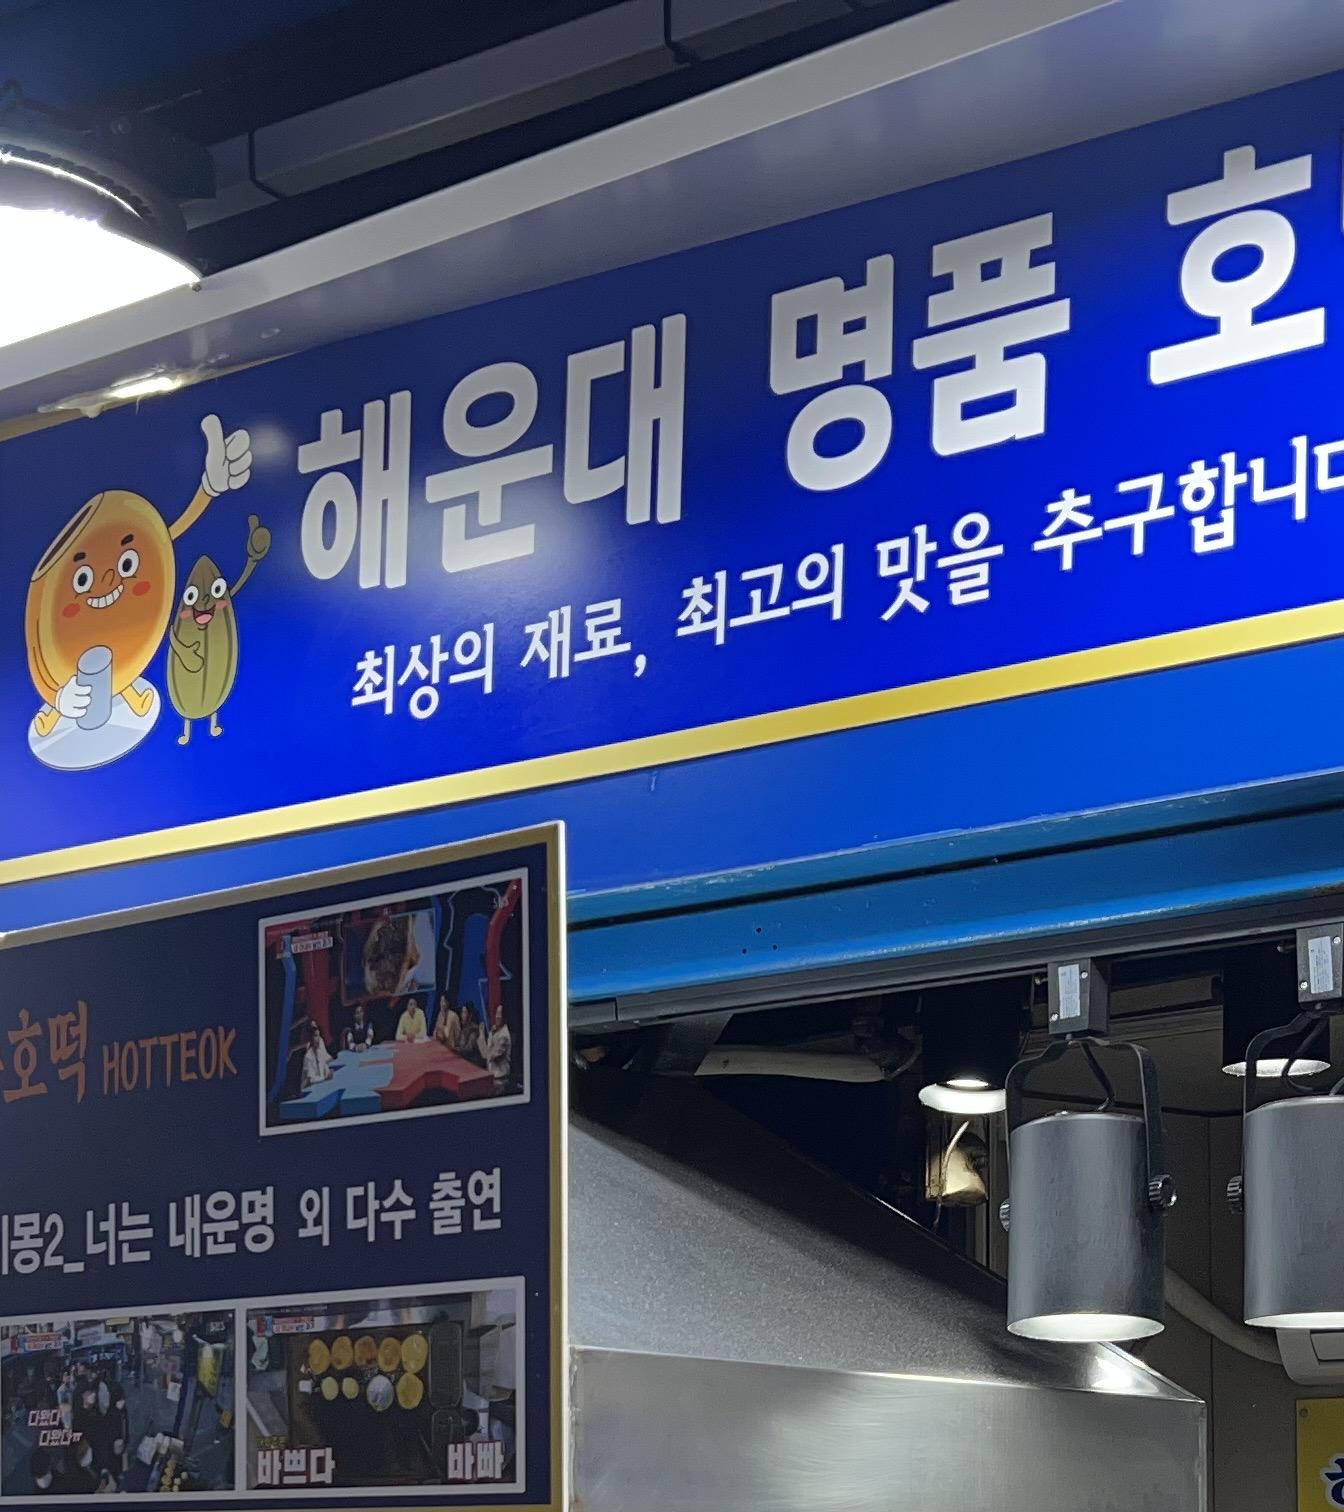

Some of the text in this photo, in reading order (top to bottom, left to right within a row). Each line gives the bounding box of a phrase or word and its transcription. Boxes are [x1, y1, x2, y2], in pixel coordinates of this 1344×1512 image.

[297, 313, 687, 590] 해운대
[768, 212, 1072, 494] 명품
[350, 622, 494, 721] 최상의
[520, 598, 648, 680] 재료,
[677, 545, 845, 645] 최고의
[876, 510, 1004, 623] 맛을
[103, 1025, 238, 1095] HOTTEOK
[169, 1186, 275, 1258] 내운명
[298, 1186, 330, 1246] 외
[346, 1178, 416, 1243] 다수
[429, 1167, 502, 1236] 출연
[256, 1447, 336, 1485] 바쁘다
[447, 1440, 505, 1481] 바빠
